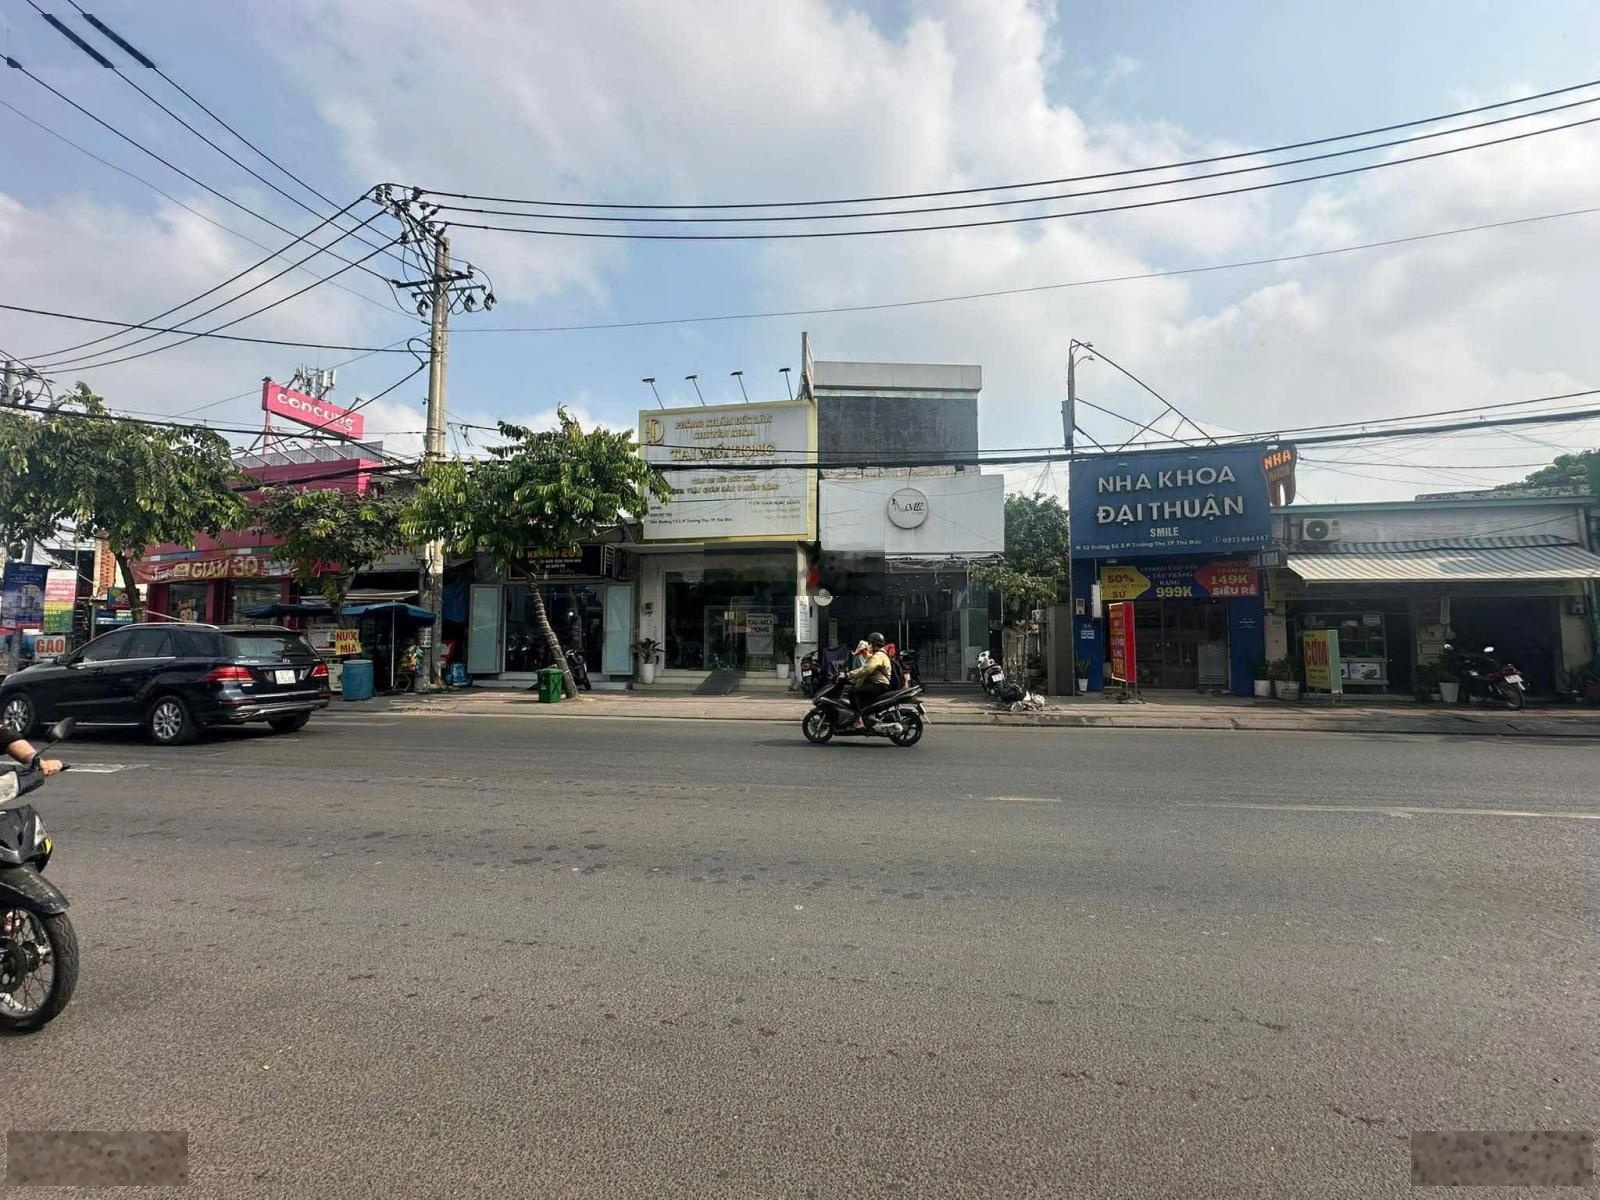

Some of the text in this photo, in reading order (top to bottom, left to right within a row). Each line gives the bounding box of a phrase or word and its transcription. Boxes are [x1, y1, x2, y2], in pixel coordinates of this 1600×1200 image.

[1264, 450, 1292, 470] NHA
[1098, 465, 1236, 493] NHA KHOA
[1096, 493, 1244, 526] ĐẠI THUẬN
[1150, 526, 1180, 538] SMILE
[1107, 574, 1135, 583] 50%
[1211, 574, 1249, 585] 149K
[1156, 585, 1193, 598] 999K
[1213, 584, 1238, 596] SIÊU
